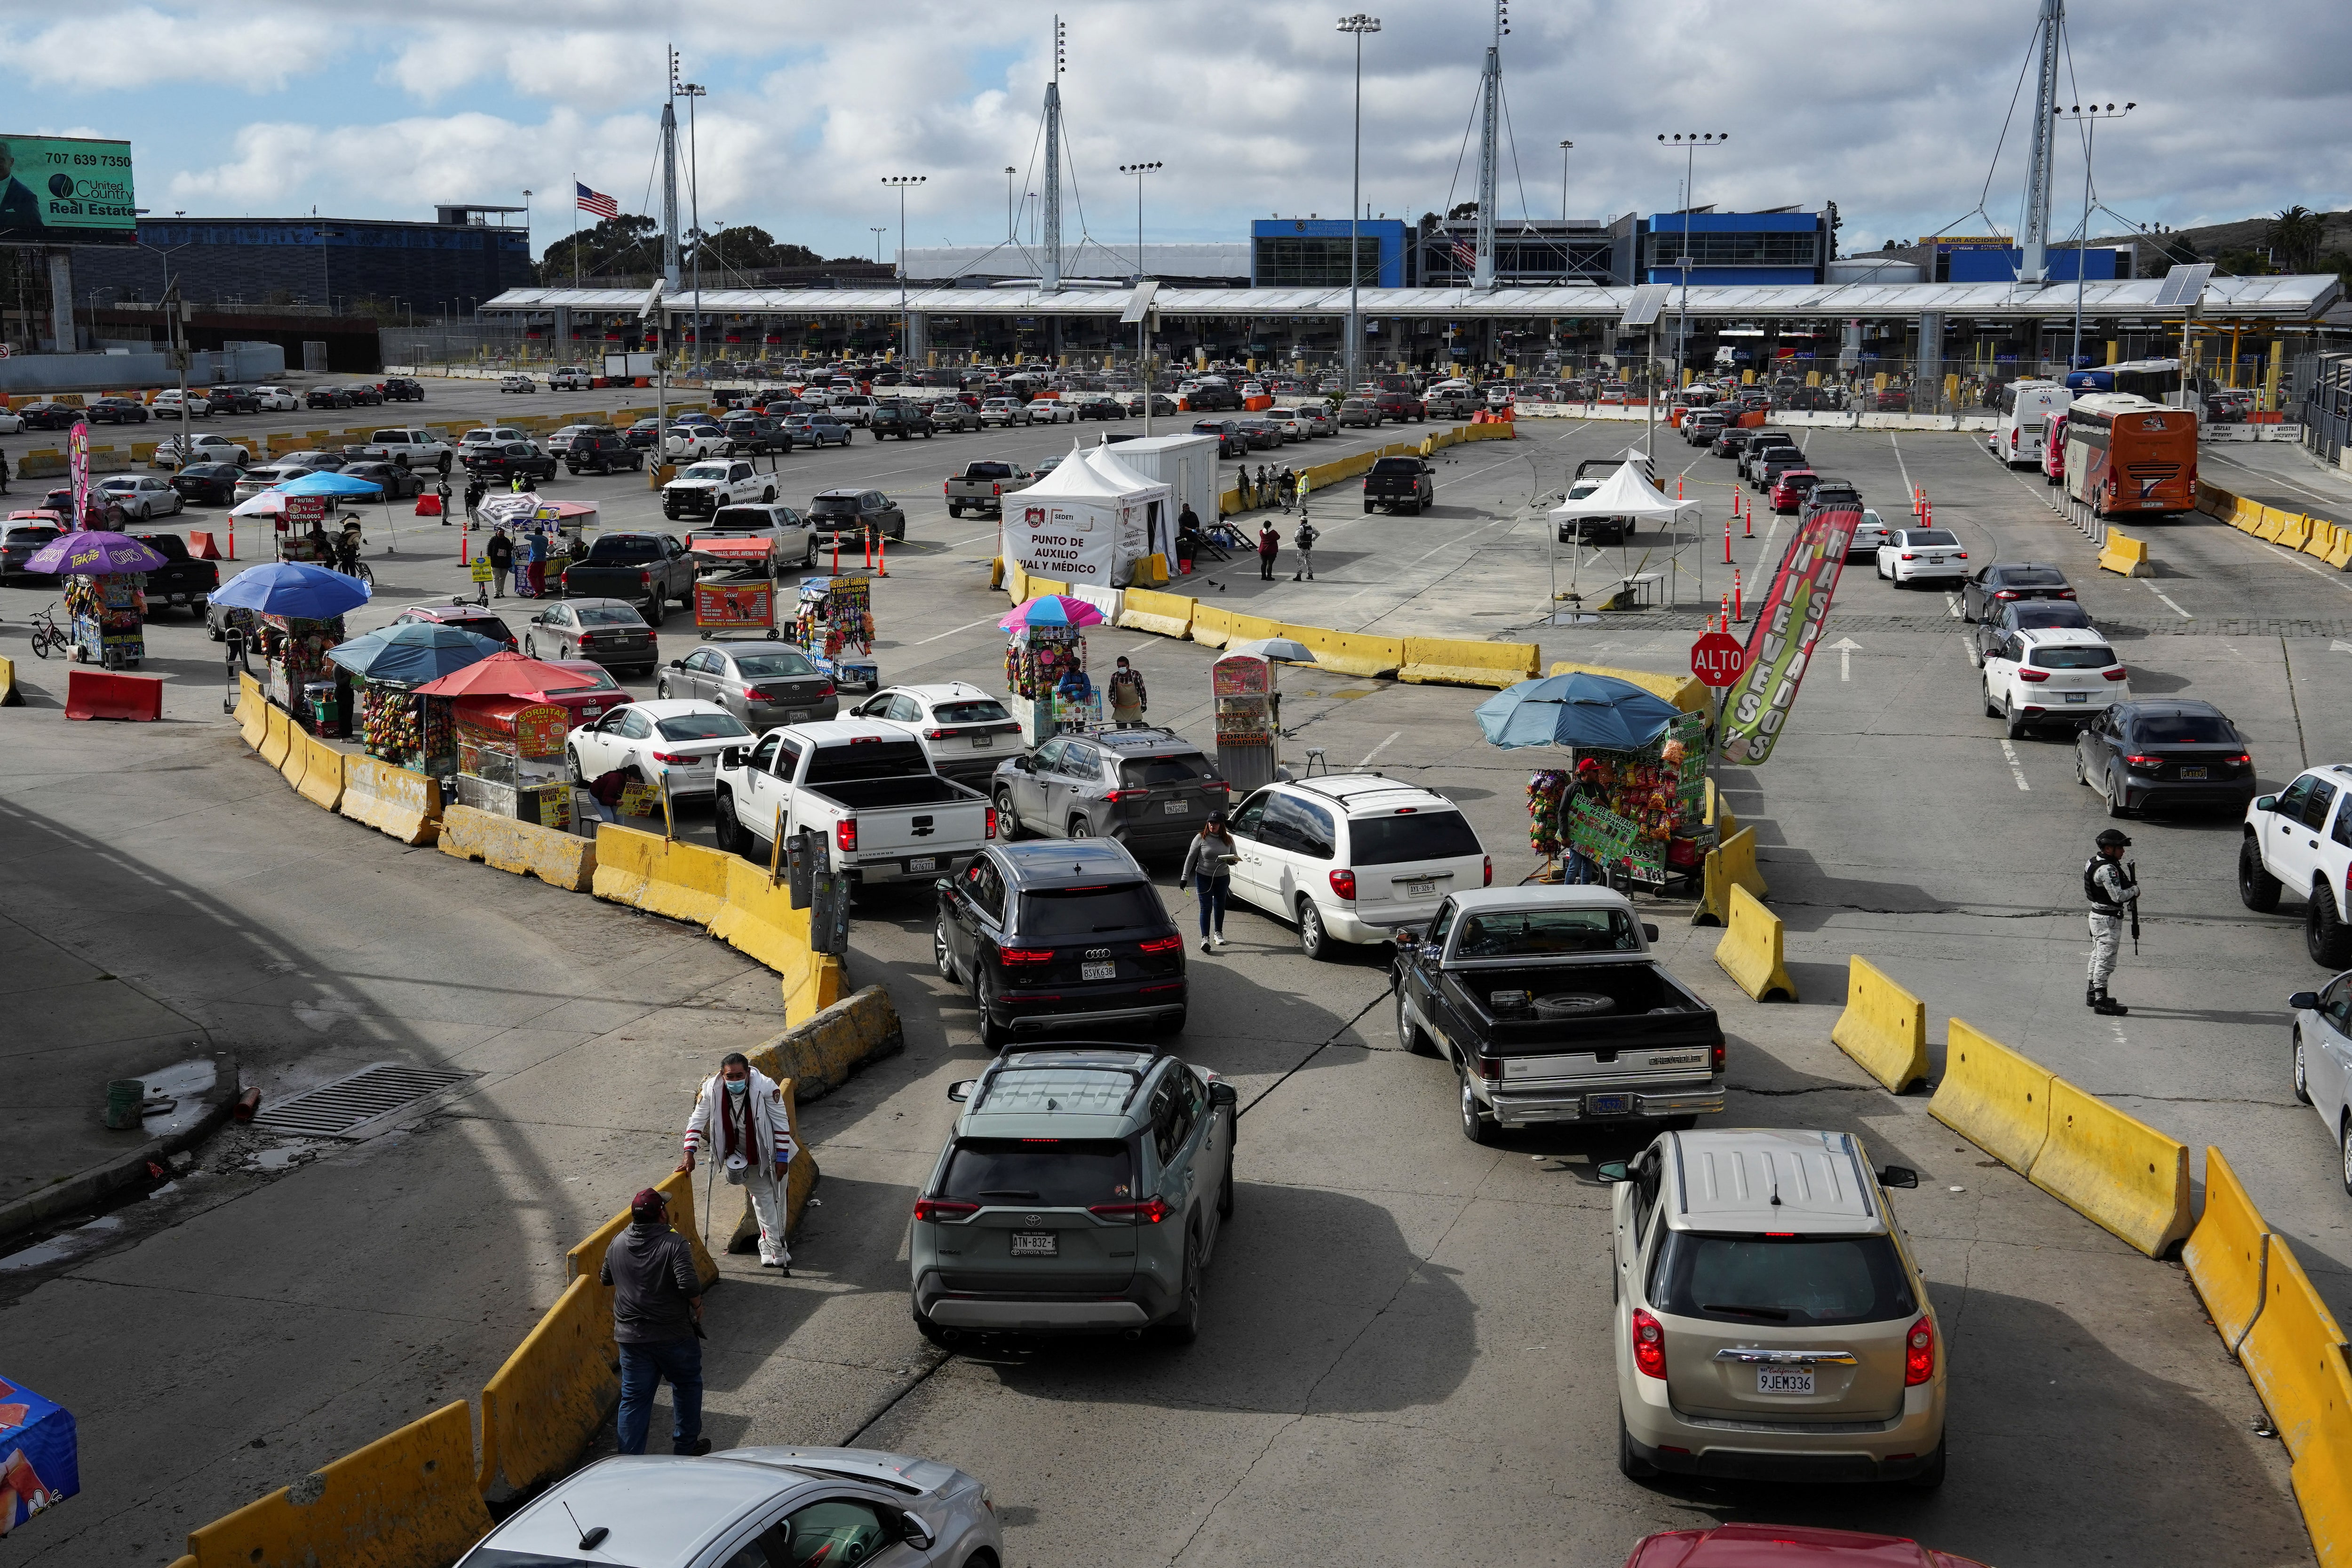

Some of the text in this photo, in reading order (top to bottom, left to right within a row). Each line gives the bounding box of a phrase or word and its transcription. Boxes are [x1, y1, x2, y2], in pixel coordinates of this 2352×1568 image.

[46, 152, 131, 167] 707 639 7350
[76, 180, 134, 202] Country
[90, 180, 123, 191] United
[49, 202, 135, 216] Real Estate
[1032, 535, 1084, 547] PUNTO DE
[70, 549, 99, 568] Takis
[1034, 548, 1078, 559] AUXILIO
[1017, 559, 1096, 573] VIAL Y MÉDICO
[830, 579, 844, 588] NIEVES
[850, 577, 869, 586] GARRAFA
[837, 586, 866, 595] RASPADOS
[1734, 542, 1814, 724] NIEVES
[1749, 528, 1849, 761] RASPADOS
[816, 660, 832, 669] TEJUINO
[1694, 649, 1741, 670] ALTO
[519, 708, 566, 722] GORDITAS
[1677, 711, 1699, 726] NIEVES
[457, 718, 484, 731] GORDITAS
[1680, 724, 1705, 740] GARRAFA
[540, 787, 560, 796] GORDITAS
[1676, 784, 1706, 799] ASPADOS
[1589, 809, 1631, 834] RASPADOS
[1599, 806, 1608, 815] DE
[1608, 811, 1637, 831] GARRAFA
[1689, 811, 1706, 821] BOLIS
[912, 862, 934, 870] 46767T1
[1411, 884, 1435, 893] AYX-326-A
[1084, 967, 1113, 977] 8SVK638
[1649, 1054, 1703, 1065] CHEVROLET
[1013, 1237, 1056, 1248] ATN-832-A
[1769, 1367, 1802, 1376] California
[1761, 1376, 1811, 1389] 9JEM336
